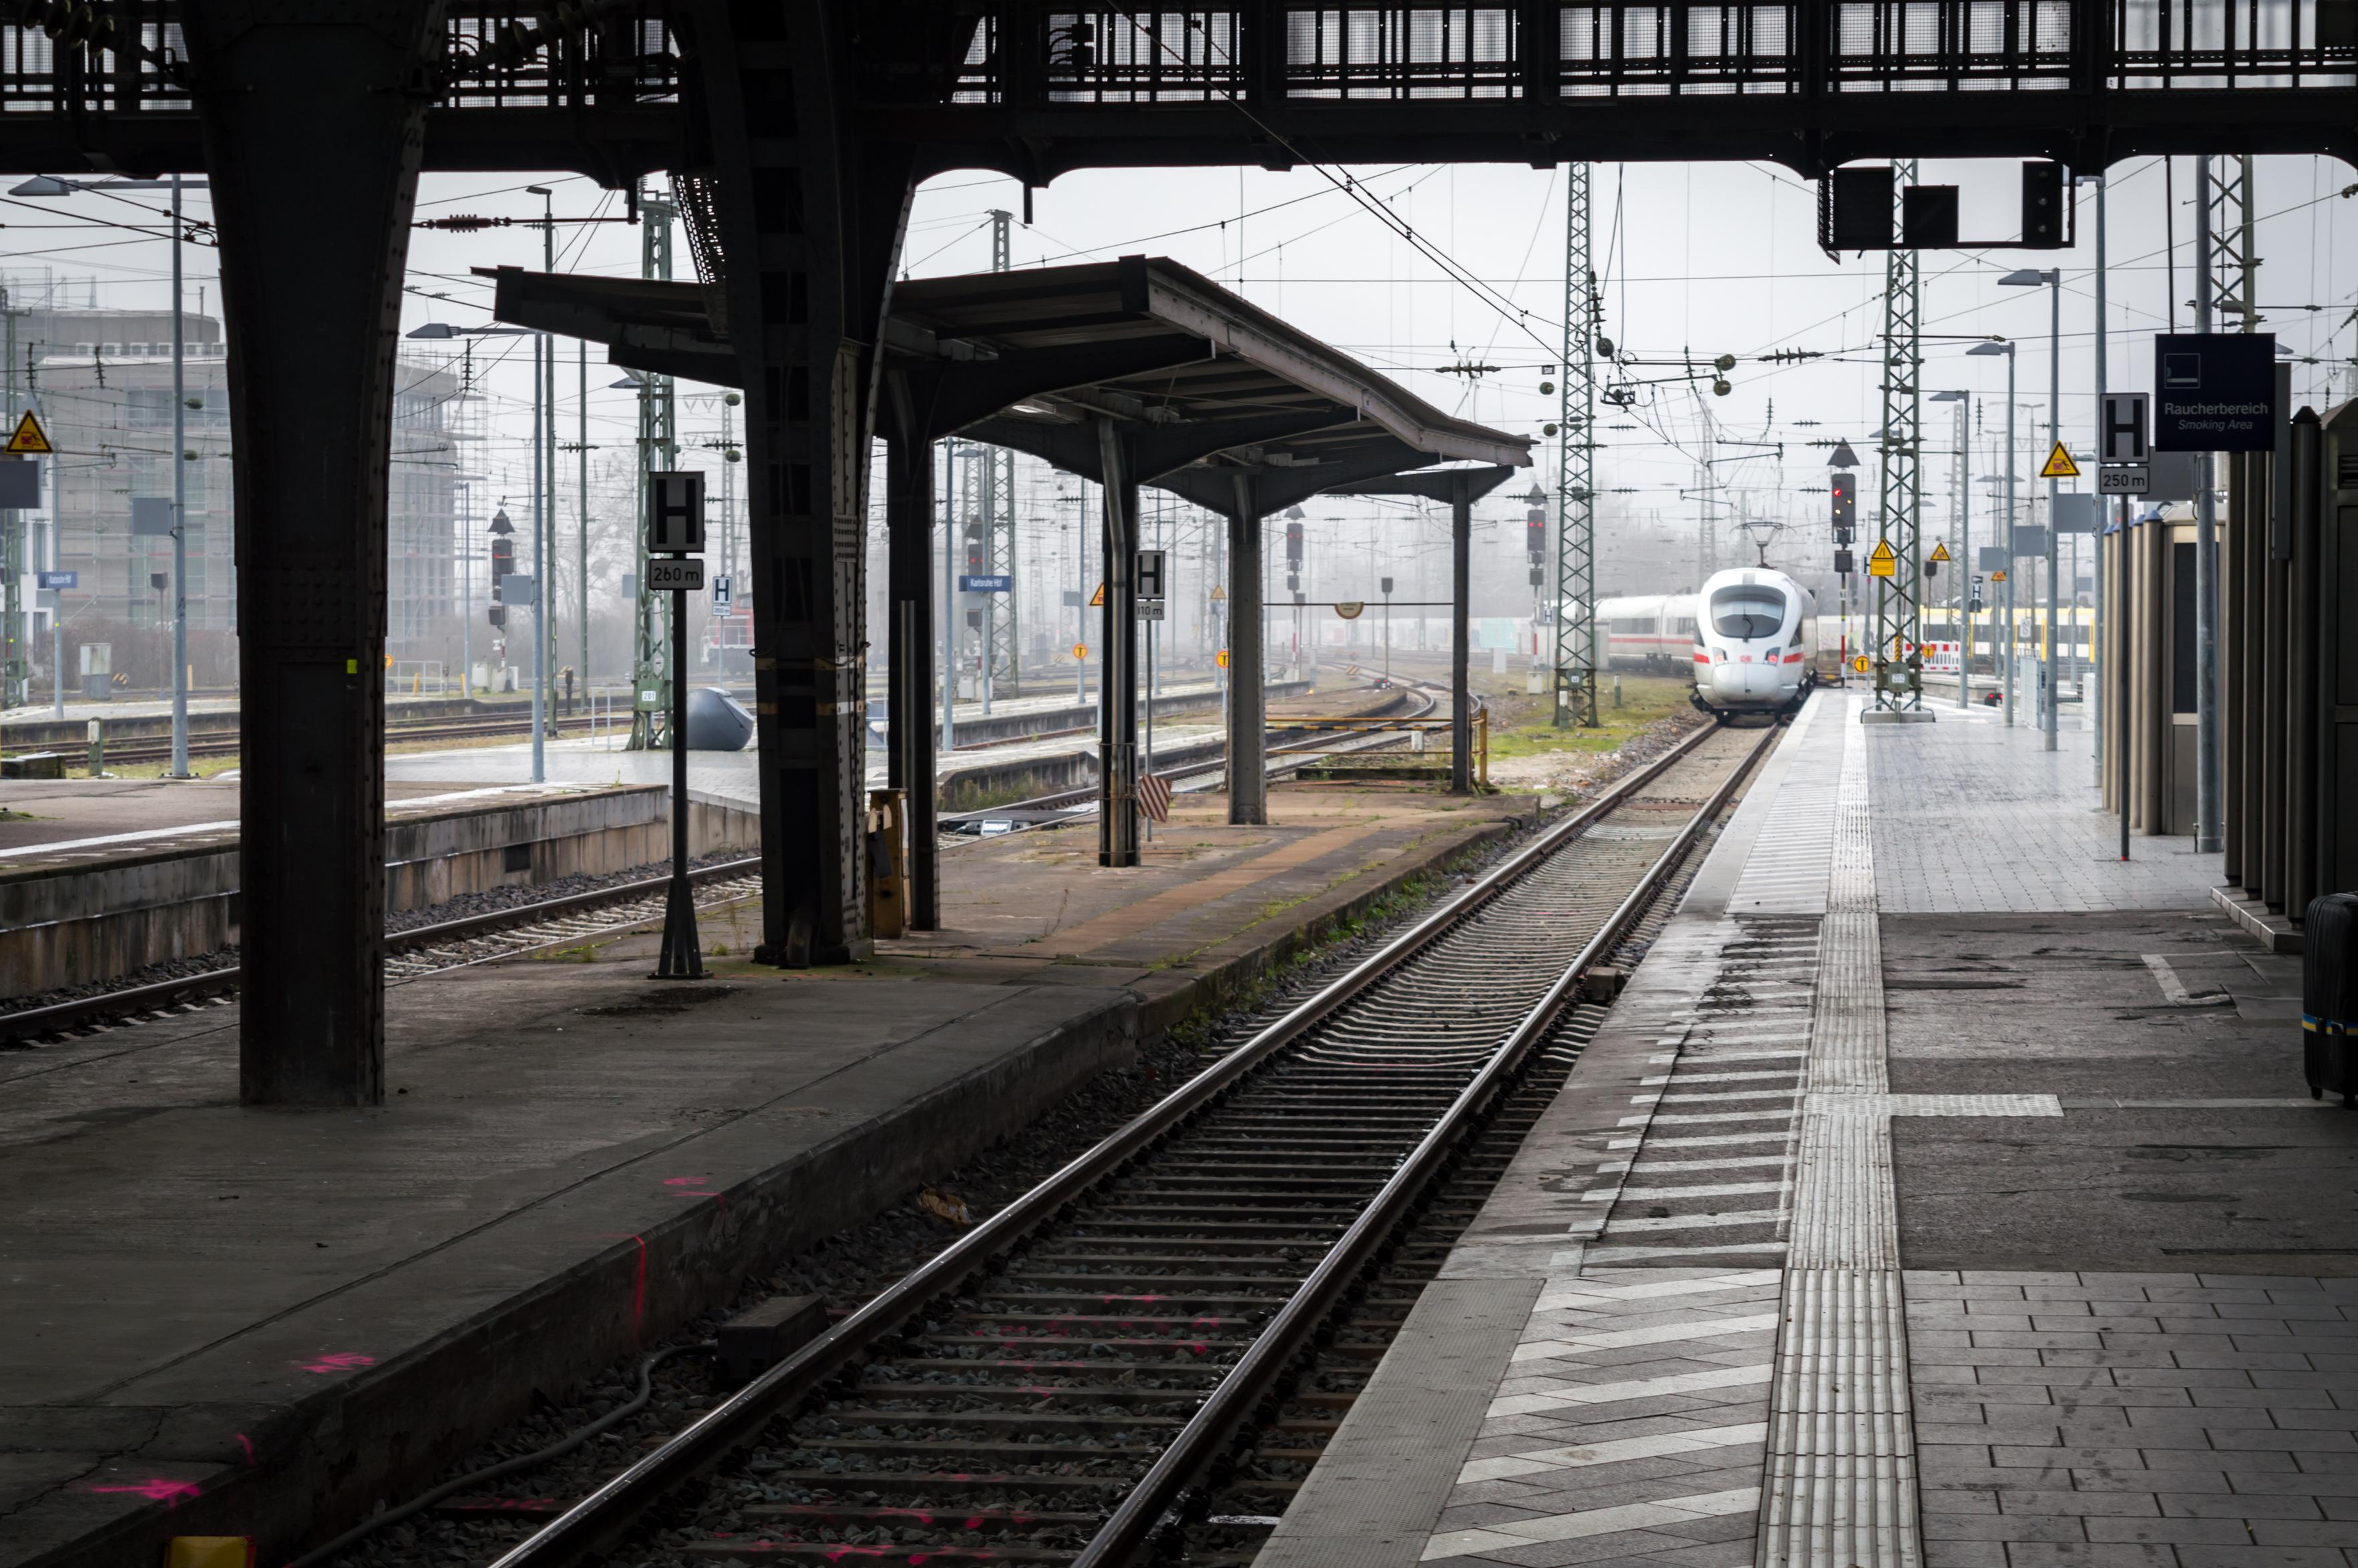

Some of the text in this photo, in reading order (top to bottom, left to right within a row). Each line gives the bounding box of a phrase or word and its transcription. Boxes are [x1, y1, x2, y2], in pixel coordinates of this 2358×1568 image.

[2164, 403, 2269, 415] Raucherbereich
[2106, 399, 2143, 457] H
[2178, 419, 2252, 431] Smoking Area
[2104, 475, 2145, 487] 250 m
[656, 479, 697, 544] H
[654, 568, 699, 581] 260 m
[1138, 555, 1160, 594] H
[715, 579, 729, 601] H
[1973, 586, 1981, 598] H
[1545, 610, 1553, 622] H
